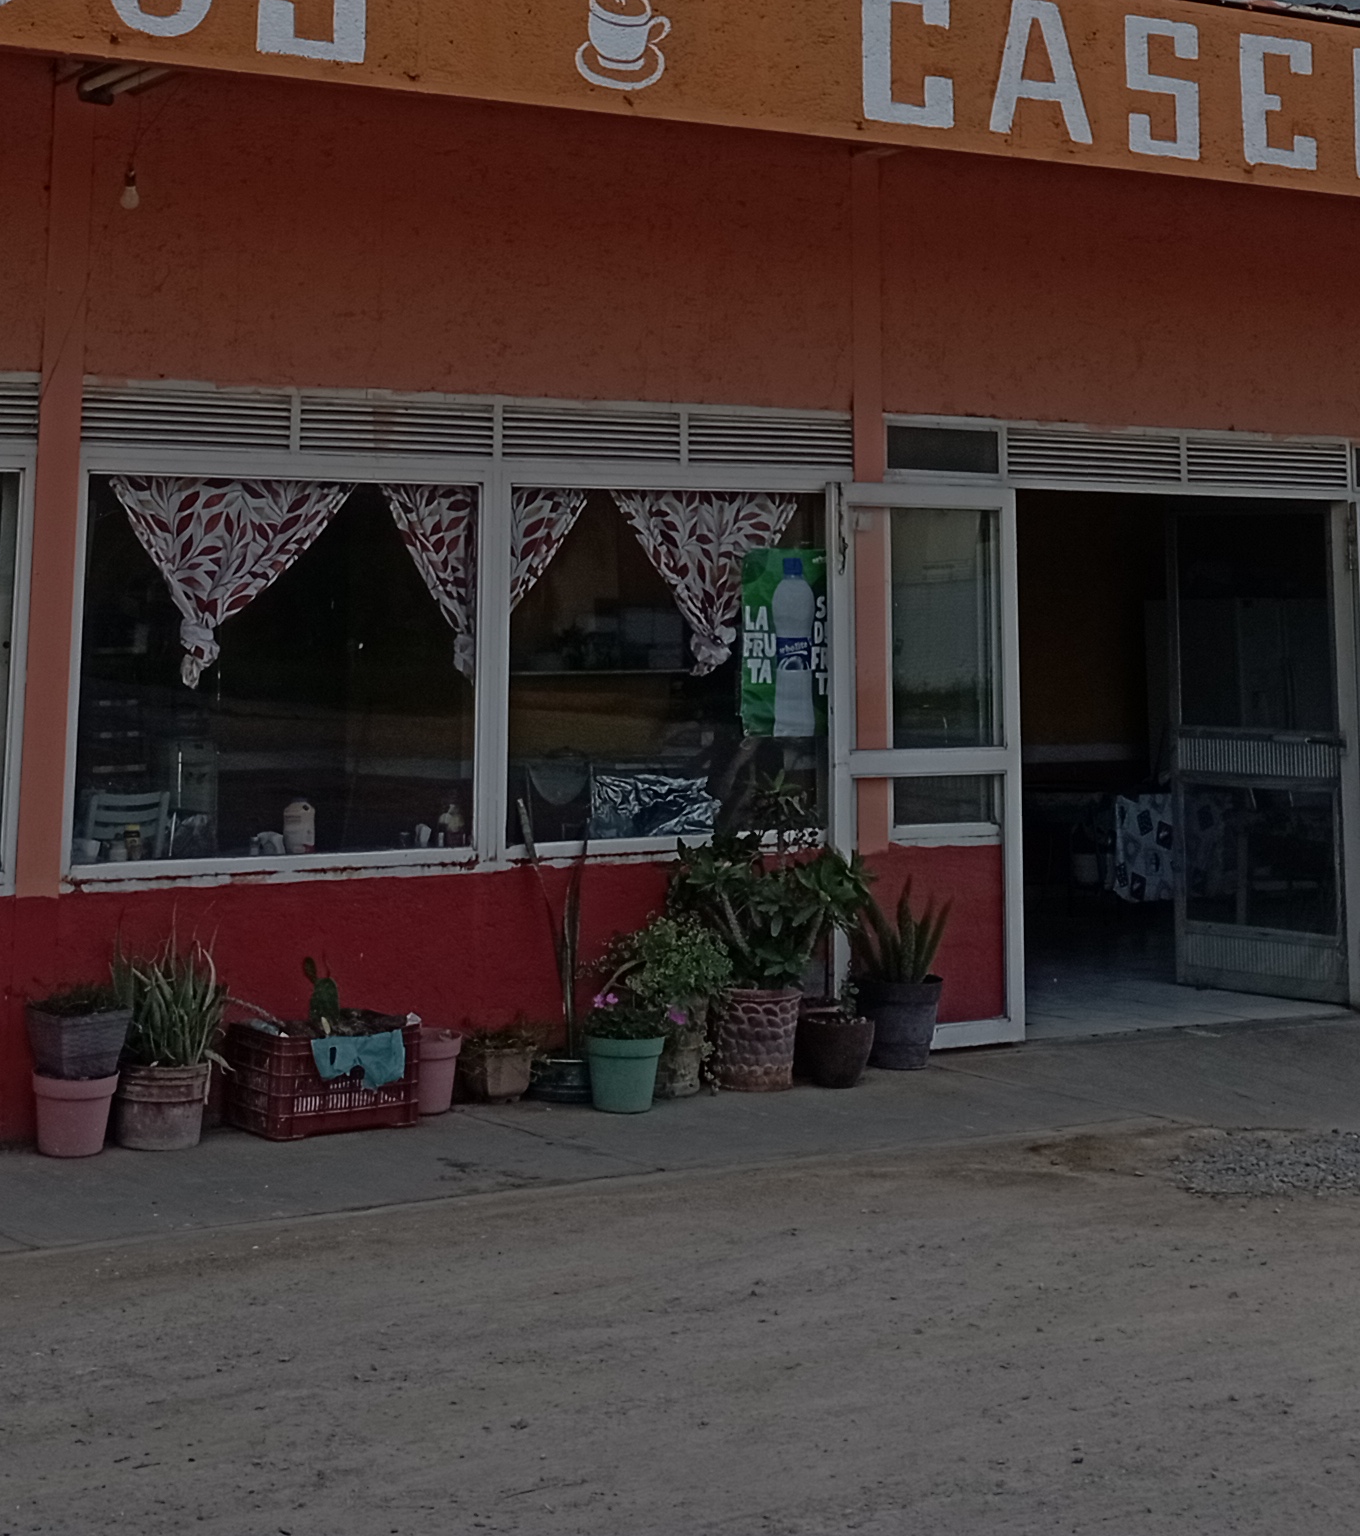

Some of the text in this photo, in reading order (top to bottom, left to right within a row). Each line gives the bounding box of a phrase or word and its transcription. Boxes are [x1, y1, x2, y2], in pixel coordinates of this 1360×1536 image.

[745, 605, 769, 631] LA
[743, 632, 777, 657] FRU
[747, 658, 772, 684] TA
